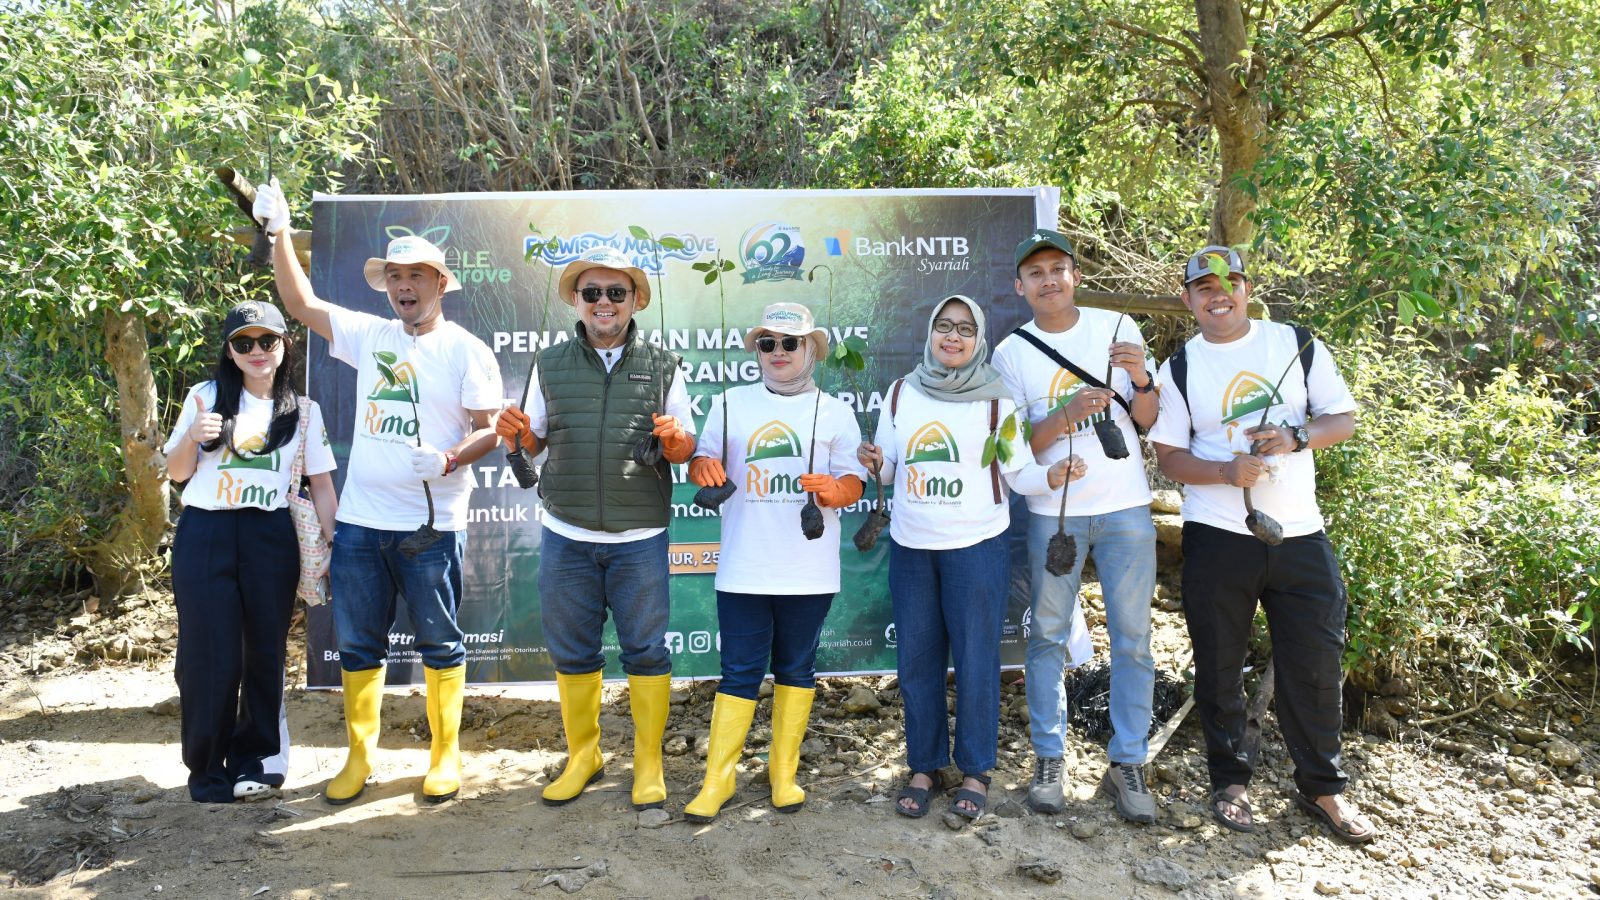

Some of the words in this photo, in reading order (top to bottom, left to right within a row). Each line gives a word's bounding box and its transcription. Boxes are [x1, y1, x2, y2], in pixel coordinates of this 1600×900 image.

[856, 236, 969, 256] BankNTB
[918, 257, 969, 275] Syariah
[681, 360, 761, 383] RANG
[365, 401, 420, 437] Rimo
[746, 463, 805, 498] Rimo
[907, 465, 964, 500] Rimo
[514, 646, 539, 654] Otoritas
